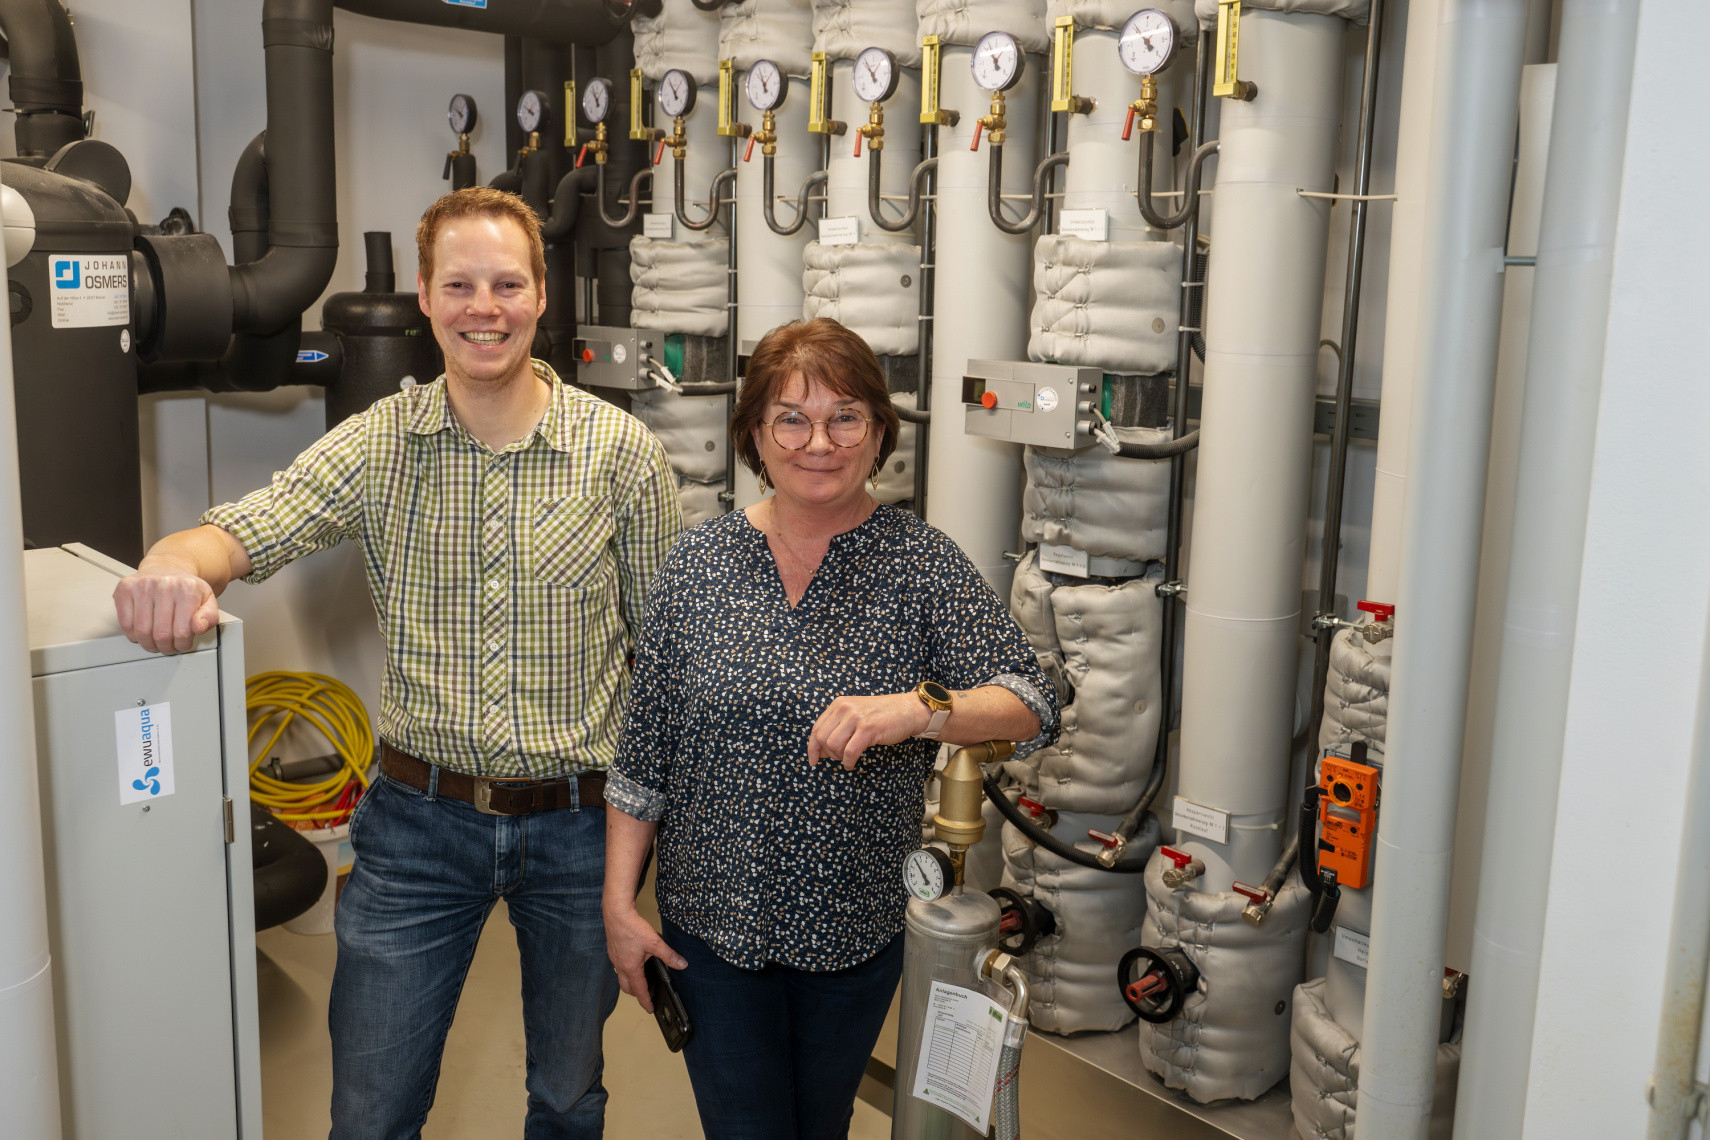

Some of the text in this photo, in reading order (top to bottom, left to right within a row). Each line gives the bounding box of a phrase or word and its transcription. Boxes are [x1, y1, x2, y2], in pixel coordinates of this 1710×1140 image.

[84, 260, 126, 270] JOHANN
[85, 275, 128, 289] OSMERS
[140, 708, 154, 766] ewuaqua
[936, 988, 968, 999] Anlagenbuch
